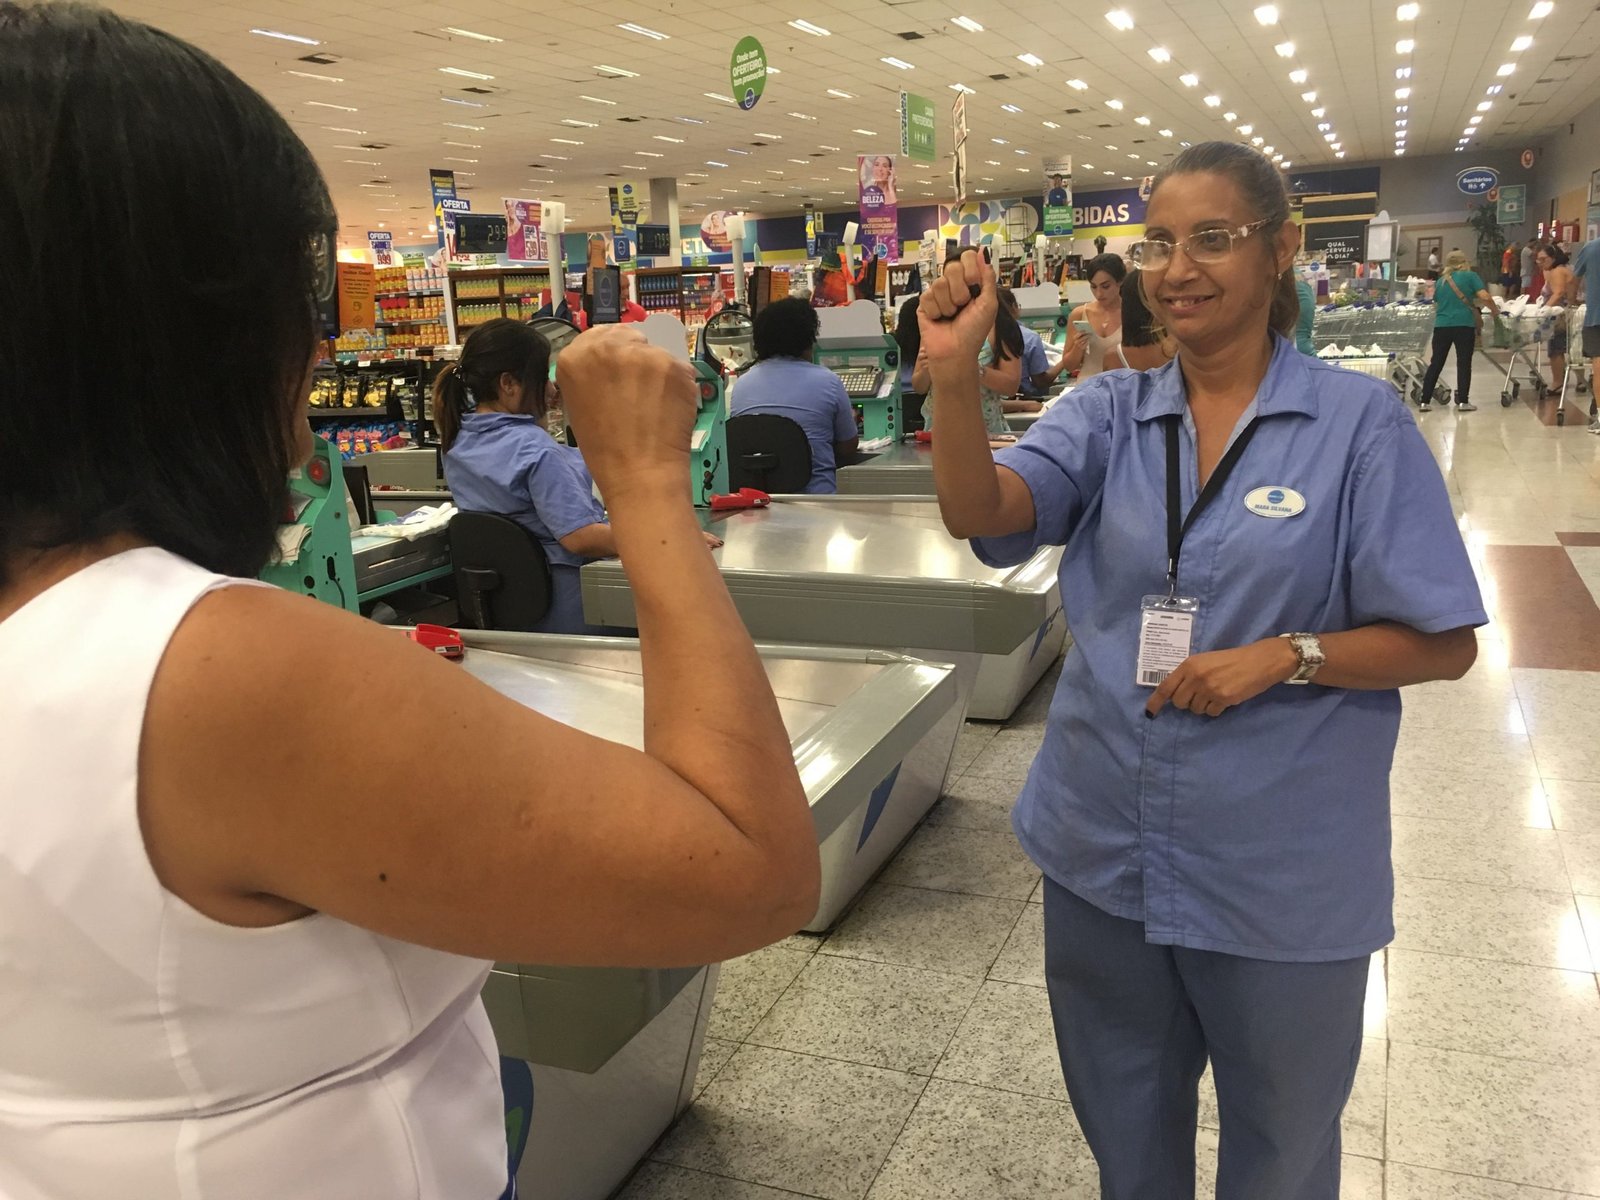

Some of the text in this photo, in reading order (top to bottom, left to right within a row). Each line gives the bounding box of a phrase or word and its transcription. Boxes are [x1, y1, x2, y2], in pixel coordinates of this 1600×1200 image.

[736, 52, 749, 63] Onde
[442, 199, 468, 210] OFERTA
[862, 195, 884, 204] BELEZA
